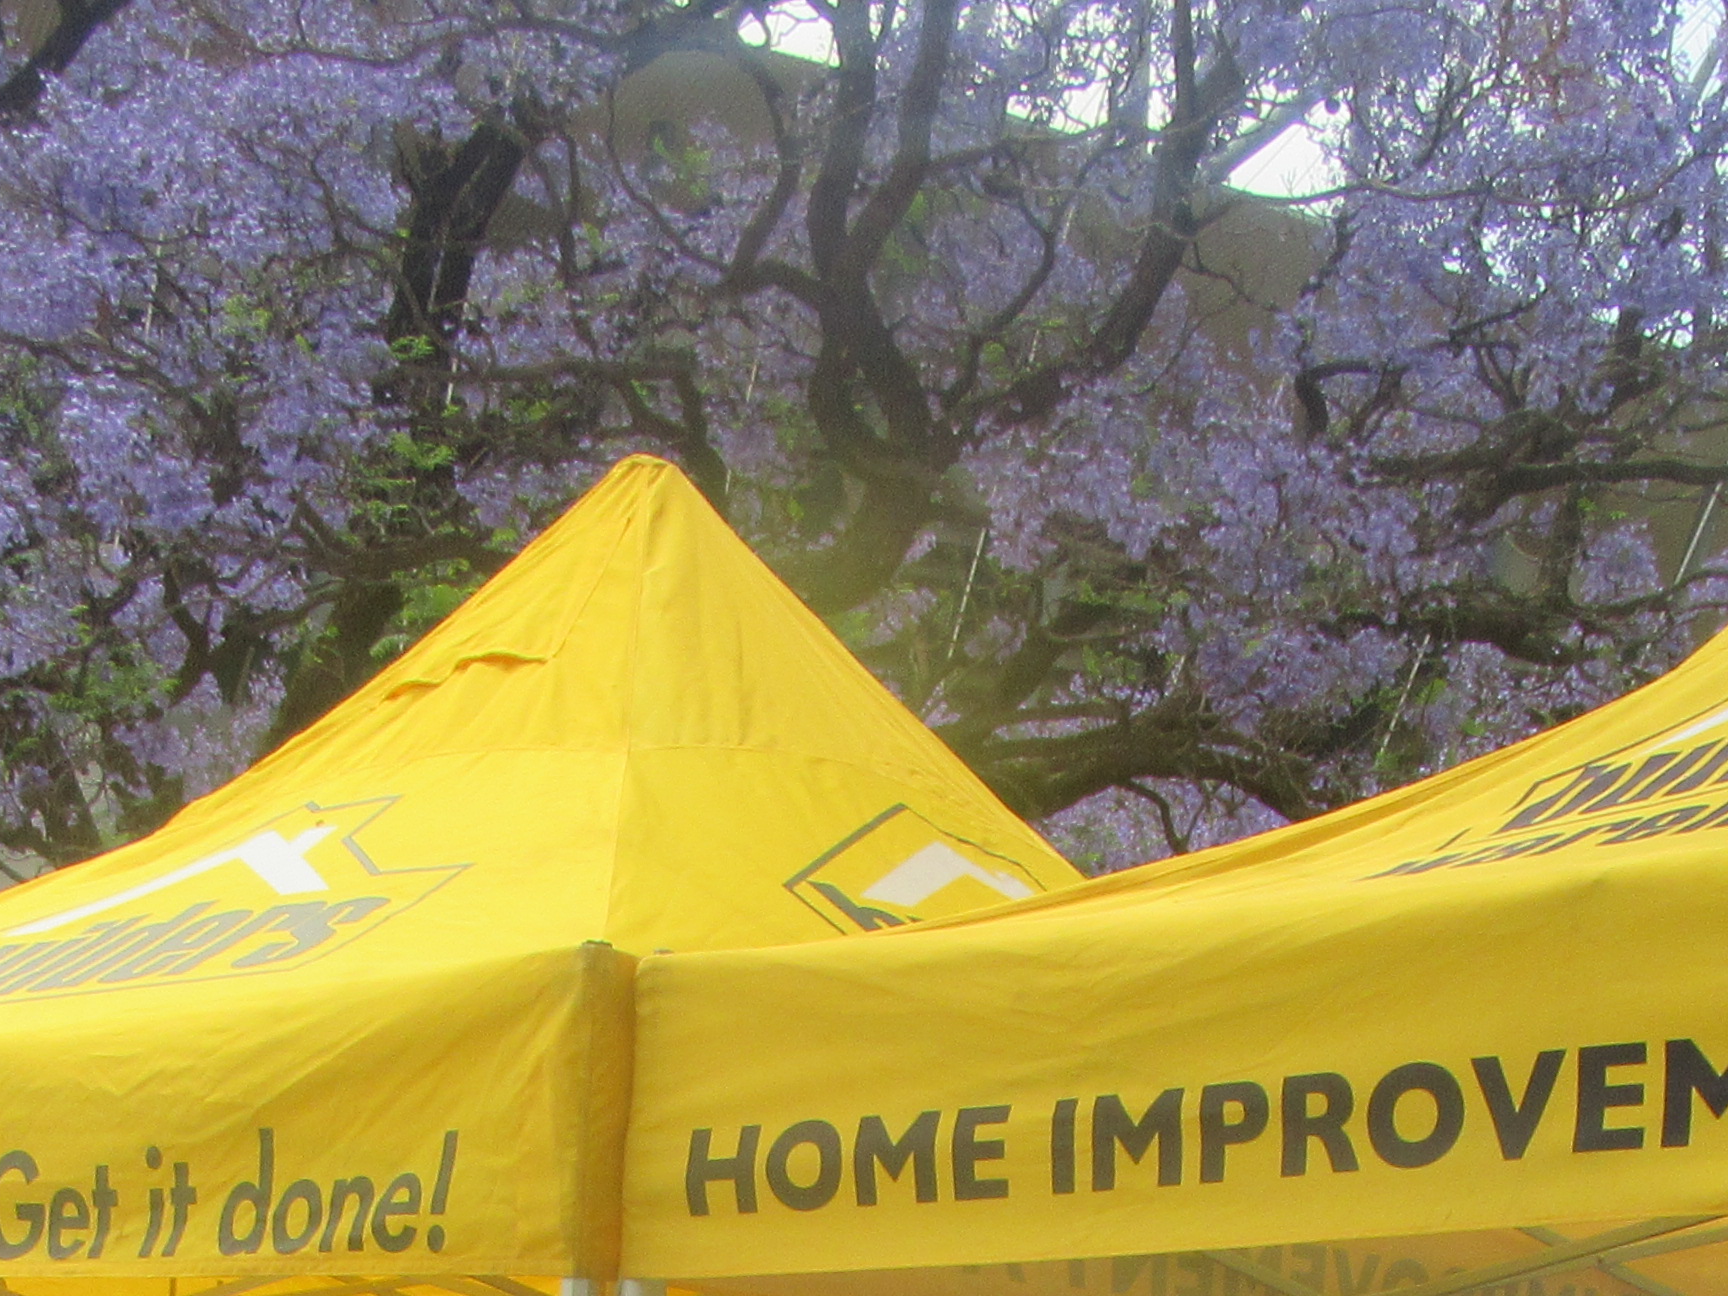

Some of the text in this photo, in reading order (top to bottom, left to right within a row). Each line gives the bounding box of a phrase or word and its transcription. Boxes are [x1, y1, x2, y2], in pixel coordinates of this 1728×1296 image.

[144, 1145, 198, 1257] it
[218, 1127, 460, 1257] done!
[685, 1103, 1012, 1217] HOME
